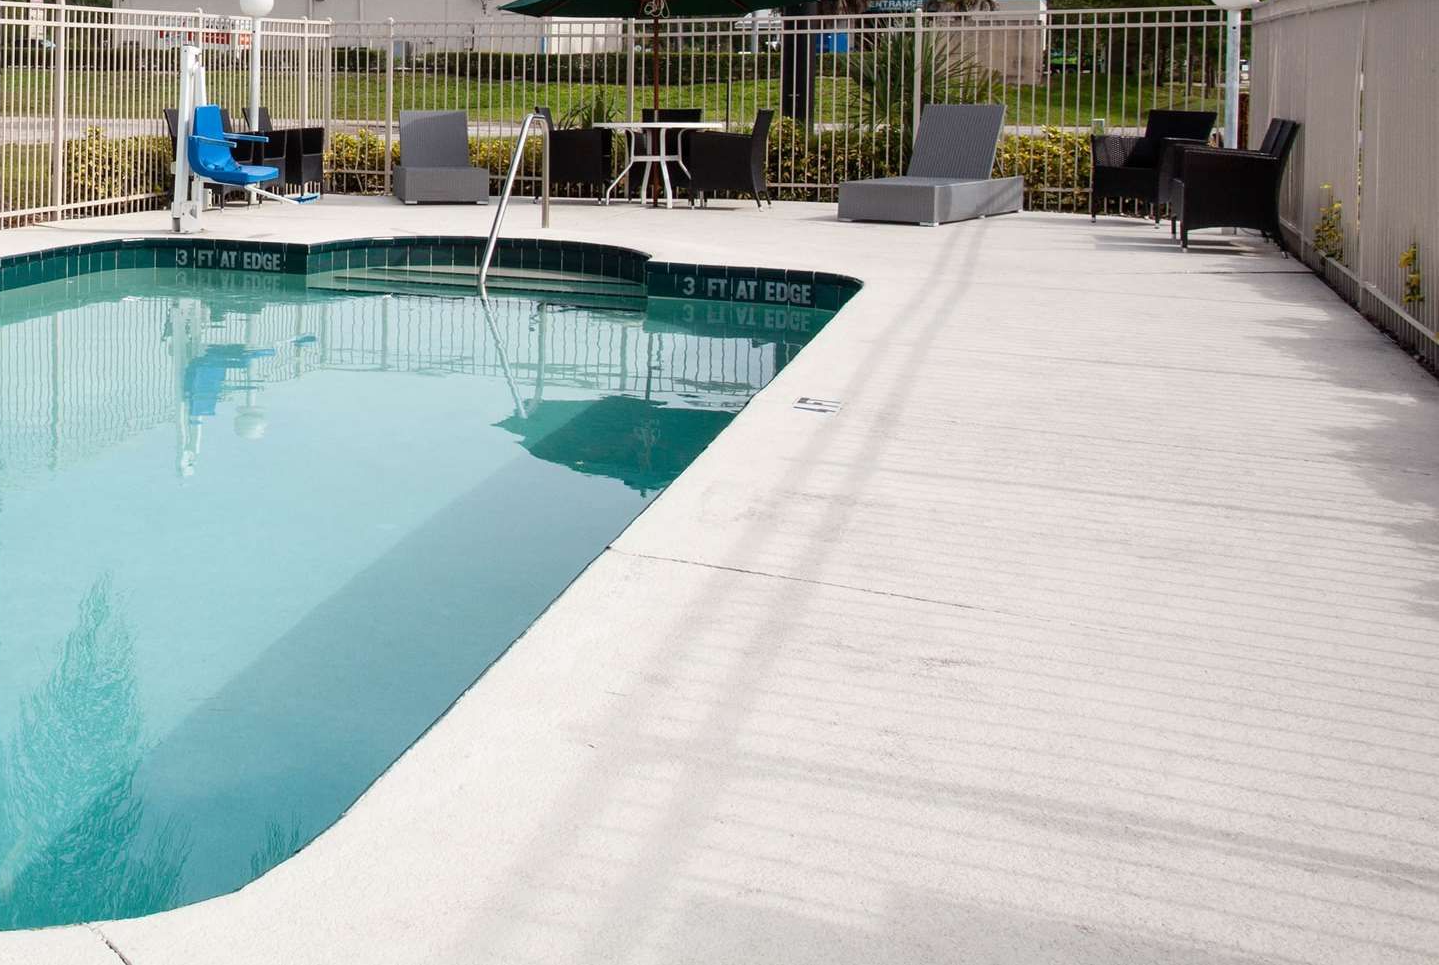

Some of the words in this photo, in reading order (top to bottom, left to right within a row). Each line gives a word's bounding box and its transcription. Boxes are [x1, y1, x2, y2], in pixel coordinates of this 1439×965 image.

[869, 0, 923, 8] ENTRANCE
[177, 249, 188, 266] 3
[197, 250, 215, 267] FT
[220, 251, 238, 268] AT
[243, 252, 281, 271] EDGE
[682, 276, 695, 295] 3
[707, 278, 728, 297] FT
[736, 280, 758, 300] AT
[764, 281, 812, 304] EDGE
